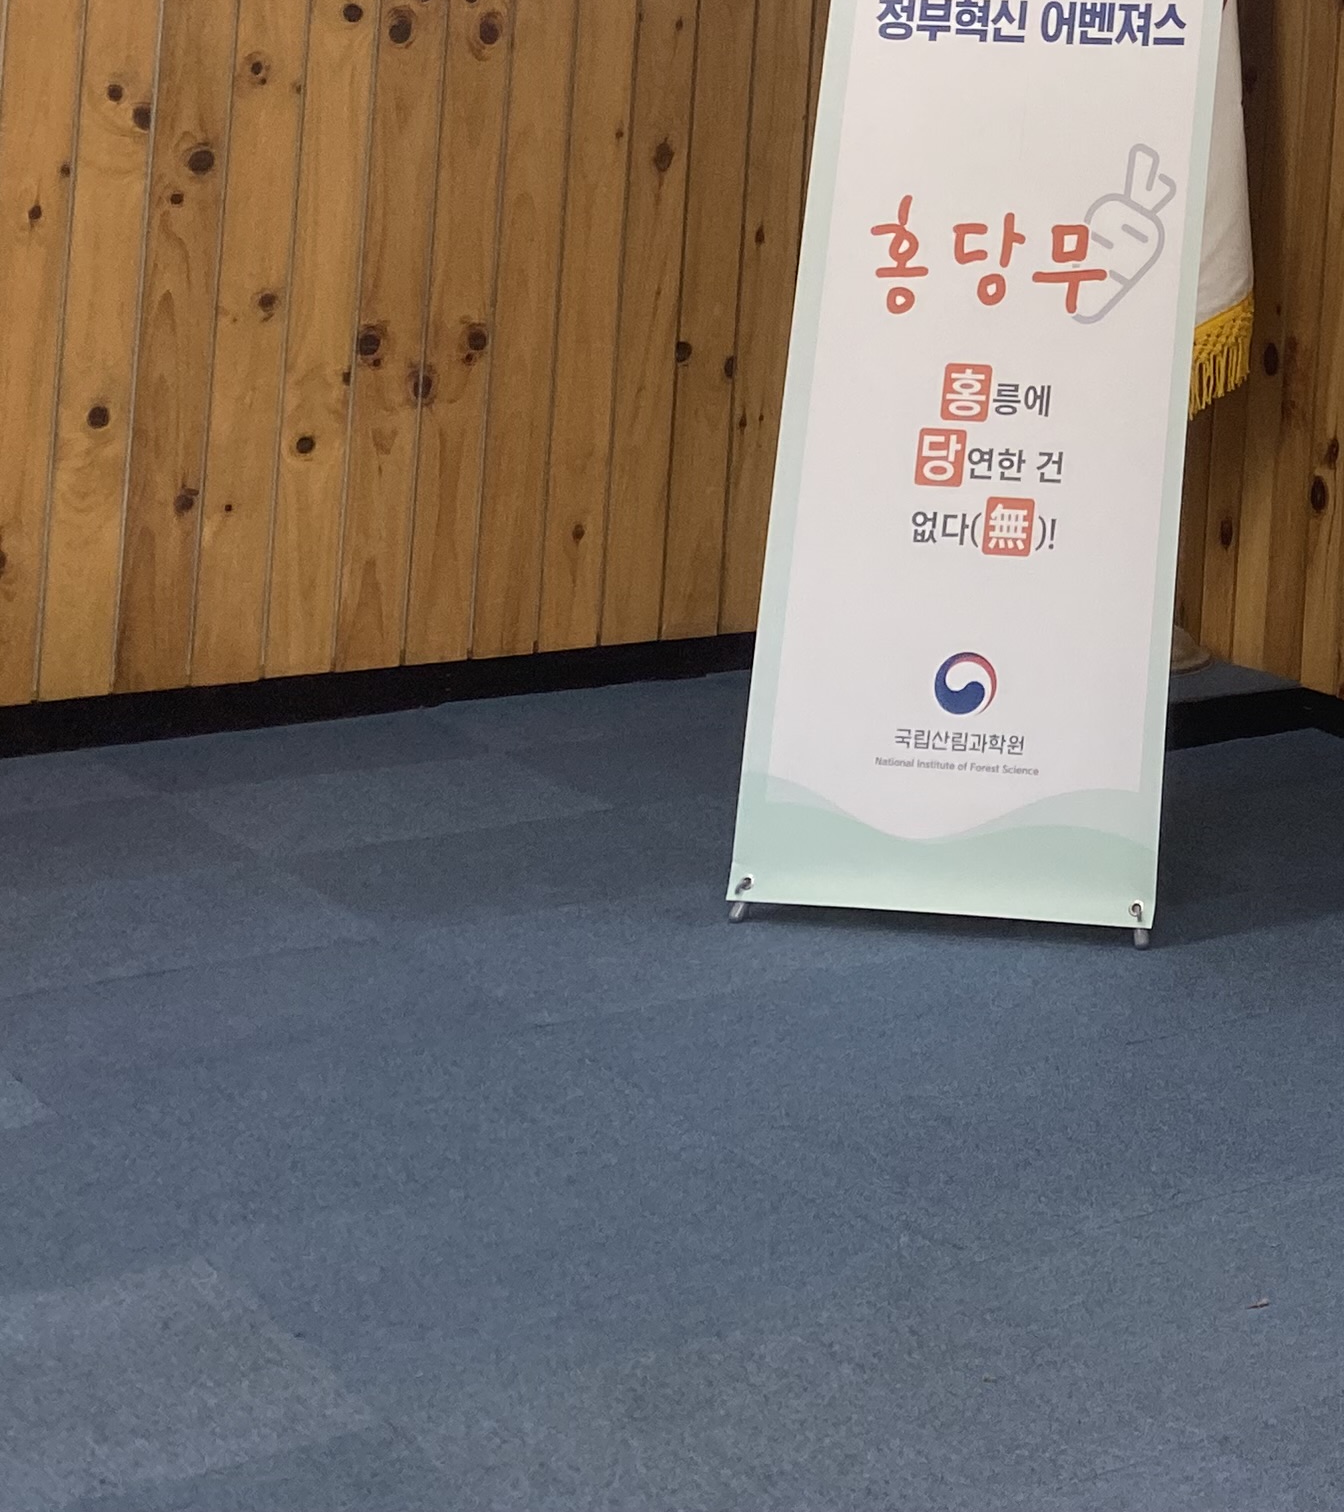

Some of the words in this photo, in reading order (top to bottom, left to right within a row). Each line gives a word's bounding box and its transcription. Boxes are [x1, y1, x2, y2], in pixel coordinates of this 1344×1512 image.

[1040, 0, 1187, 47] 어벤져스
[944, 368, 1052, 418] 홍릉에
[920, 433, 1026, 482] 당연한
[1036, 451, 1064, 484] 건
[911, 504, 1057, 551] 없다(無)!
[894, 728, 1025, 756] 국립산림과학원
[875, 756, 915, 770] National
[917, 759, 955, 772] Institute
[970, 763, 1000, 775] Forest
[1002, 764, 1040, 777] Science
